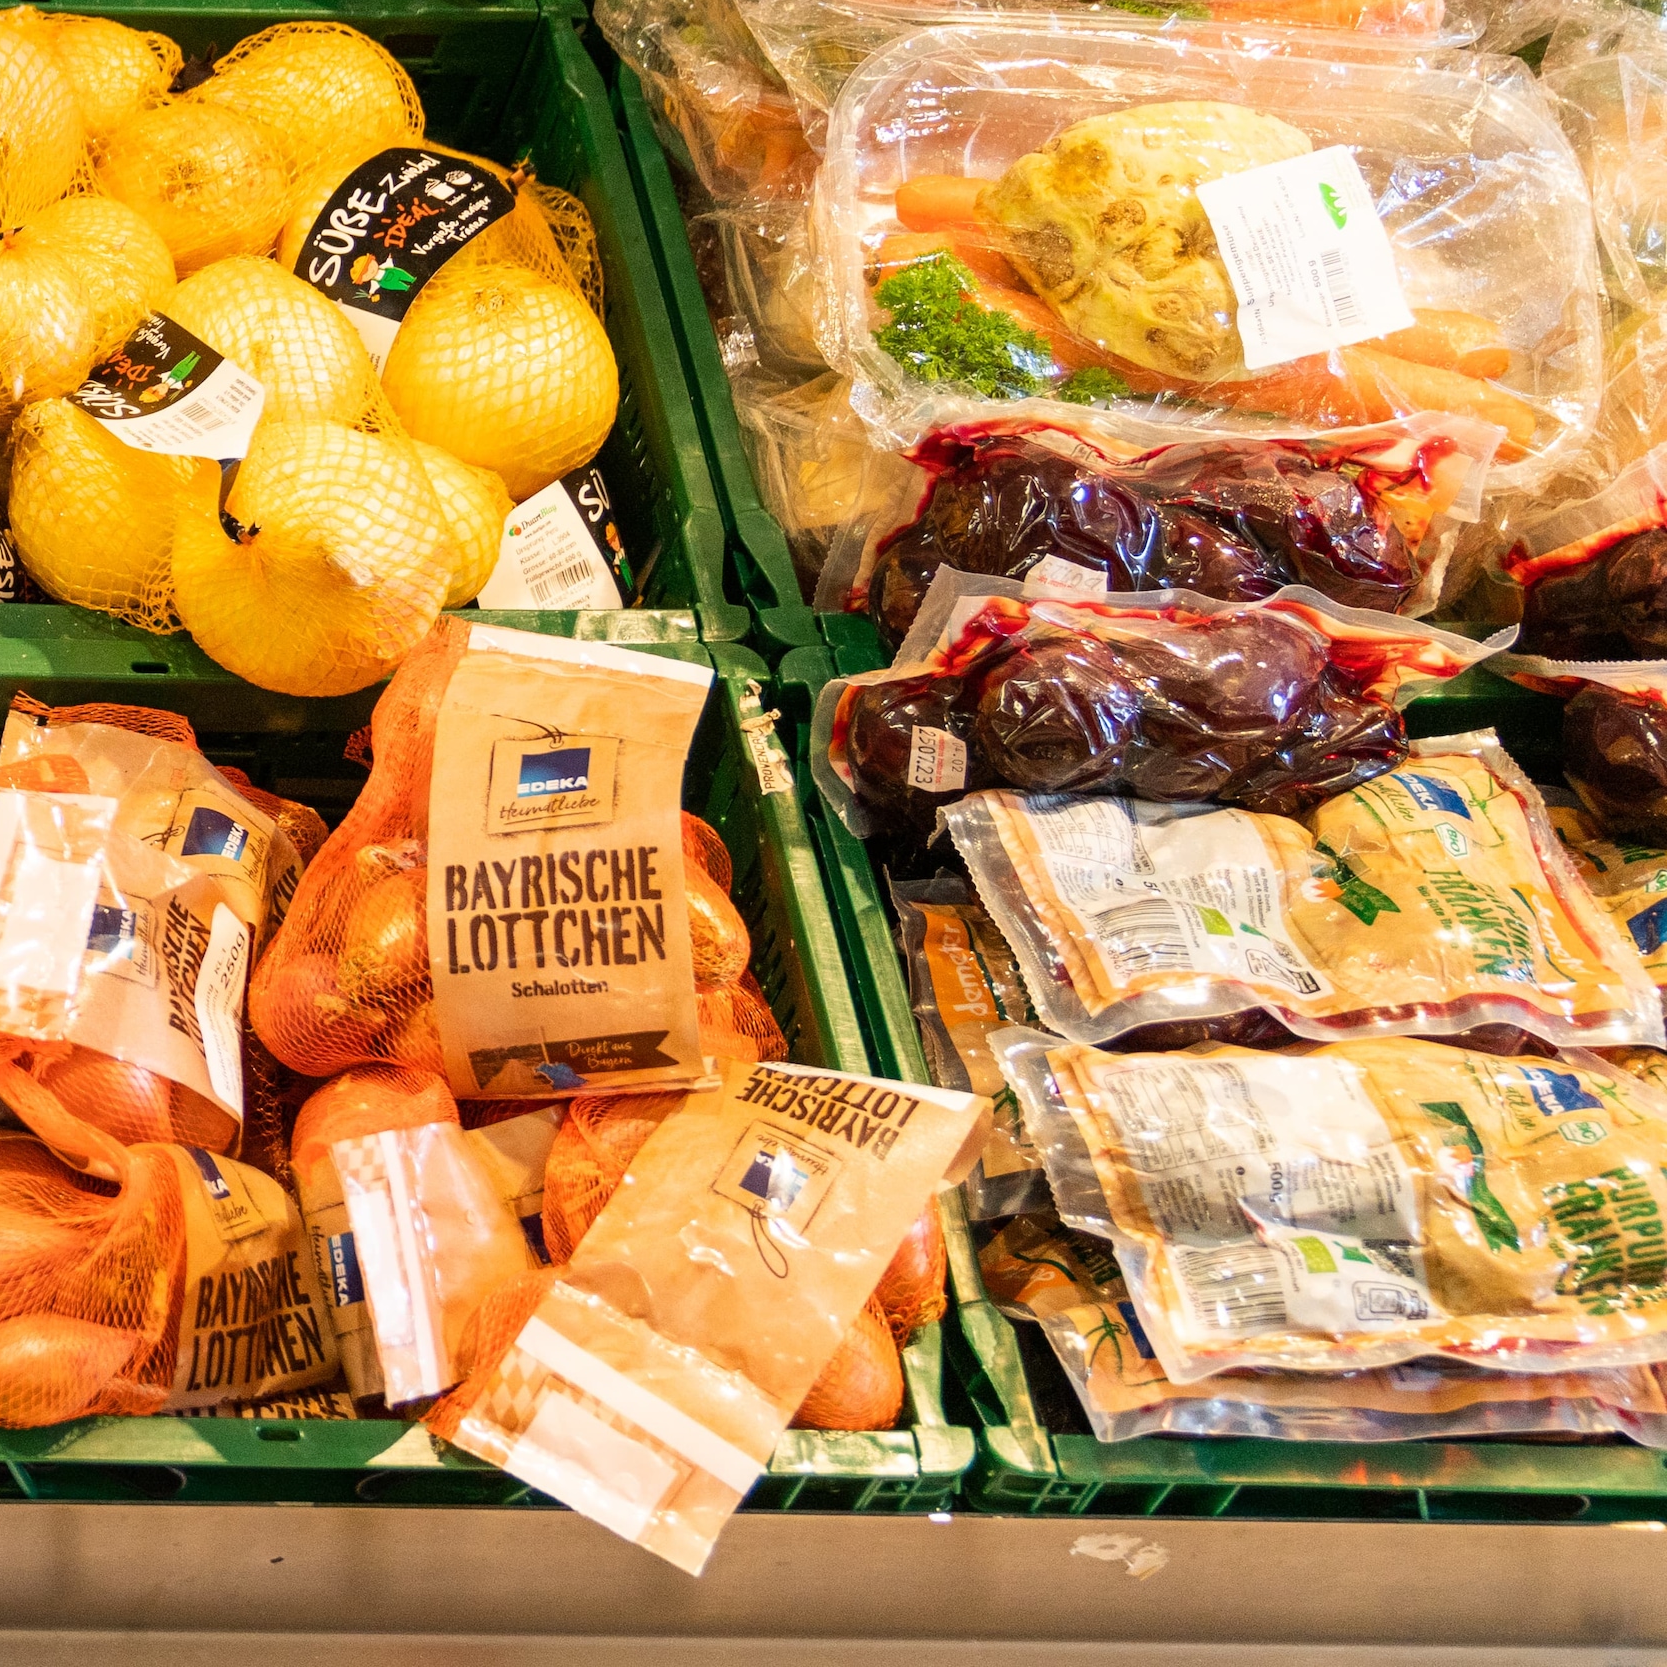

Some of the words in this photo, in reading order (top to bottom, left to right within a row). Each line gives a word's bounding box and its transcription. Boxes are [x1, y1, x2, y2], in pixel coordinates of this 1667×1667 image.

[376, 152, 440, 194] Zwiebel
[410, 219, 459, 255] Vergieße
[456, 195, 490, 221] weniger
[446, 214, 488, 241] Tränen
[1222, 224, 1255, 305] Suppengemüse
[914, 728, 935, 784] 2507.23
[498, 793, 601, 820] Heimatliebe
[516, 776, 589, 796] EDEKA
[221, 820, 246, 859] EDEKA
[443, 845, 662, 913] BAYRISCHE
[220, 931, 246, 989] 250g
[445, 903, 666, 975] LOTTCHEN
[511, 976, 609, 999] Schalotten
[564, 1040, 610, 1057] Direkt
[585, 1051, 633, 1071] Bayern
[734, 1075, 900, 1161] BAYRISCHE
[195, 1250, 311, 1329] BAYRISCHE
[329, 1234, 350, 1306] EDEKA
[189, 1306, 326, 1390] LOTTCHEN
